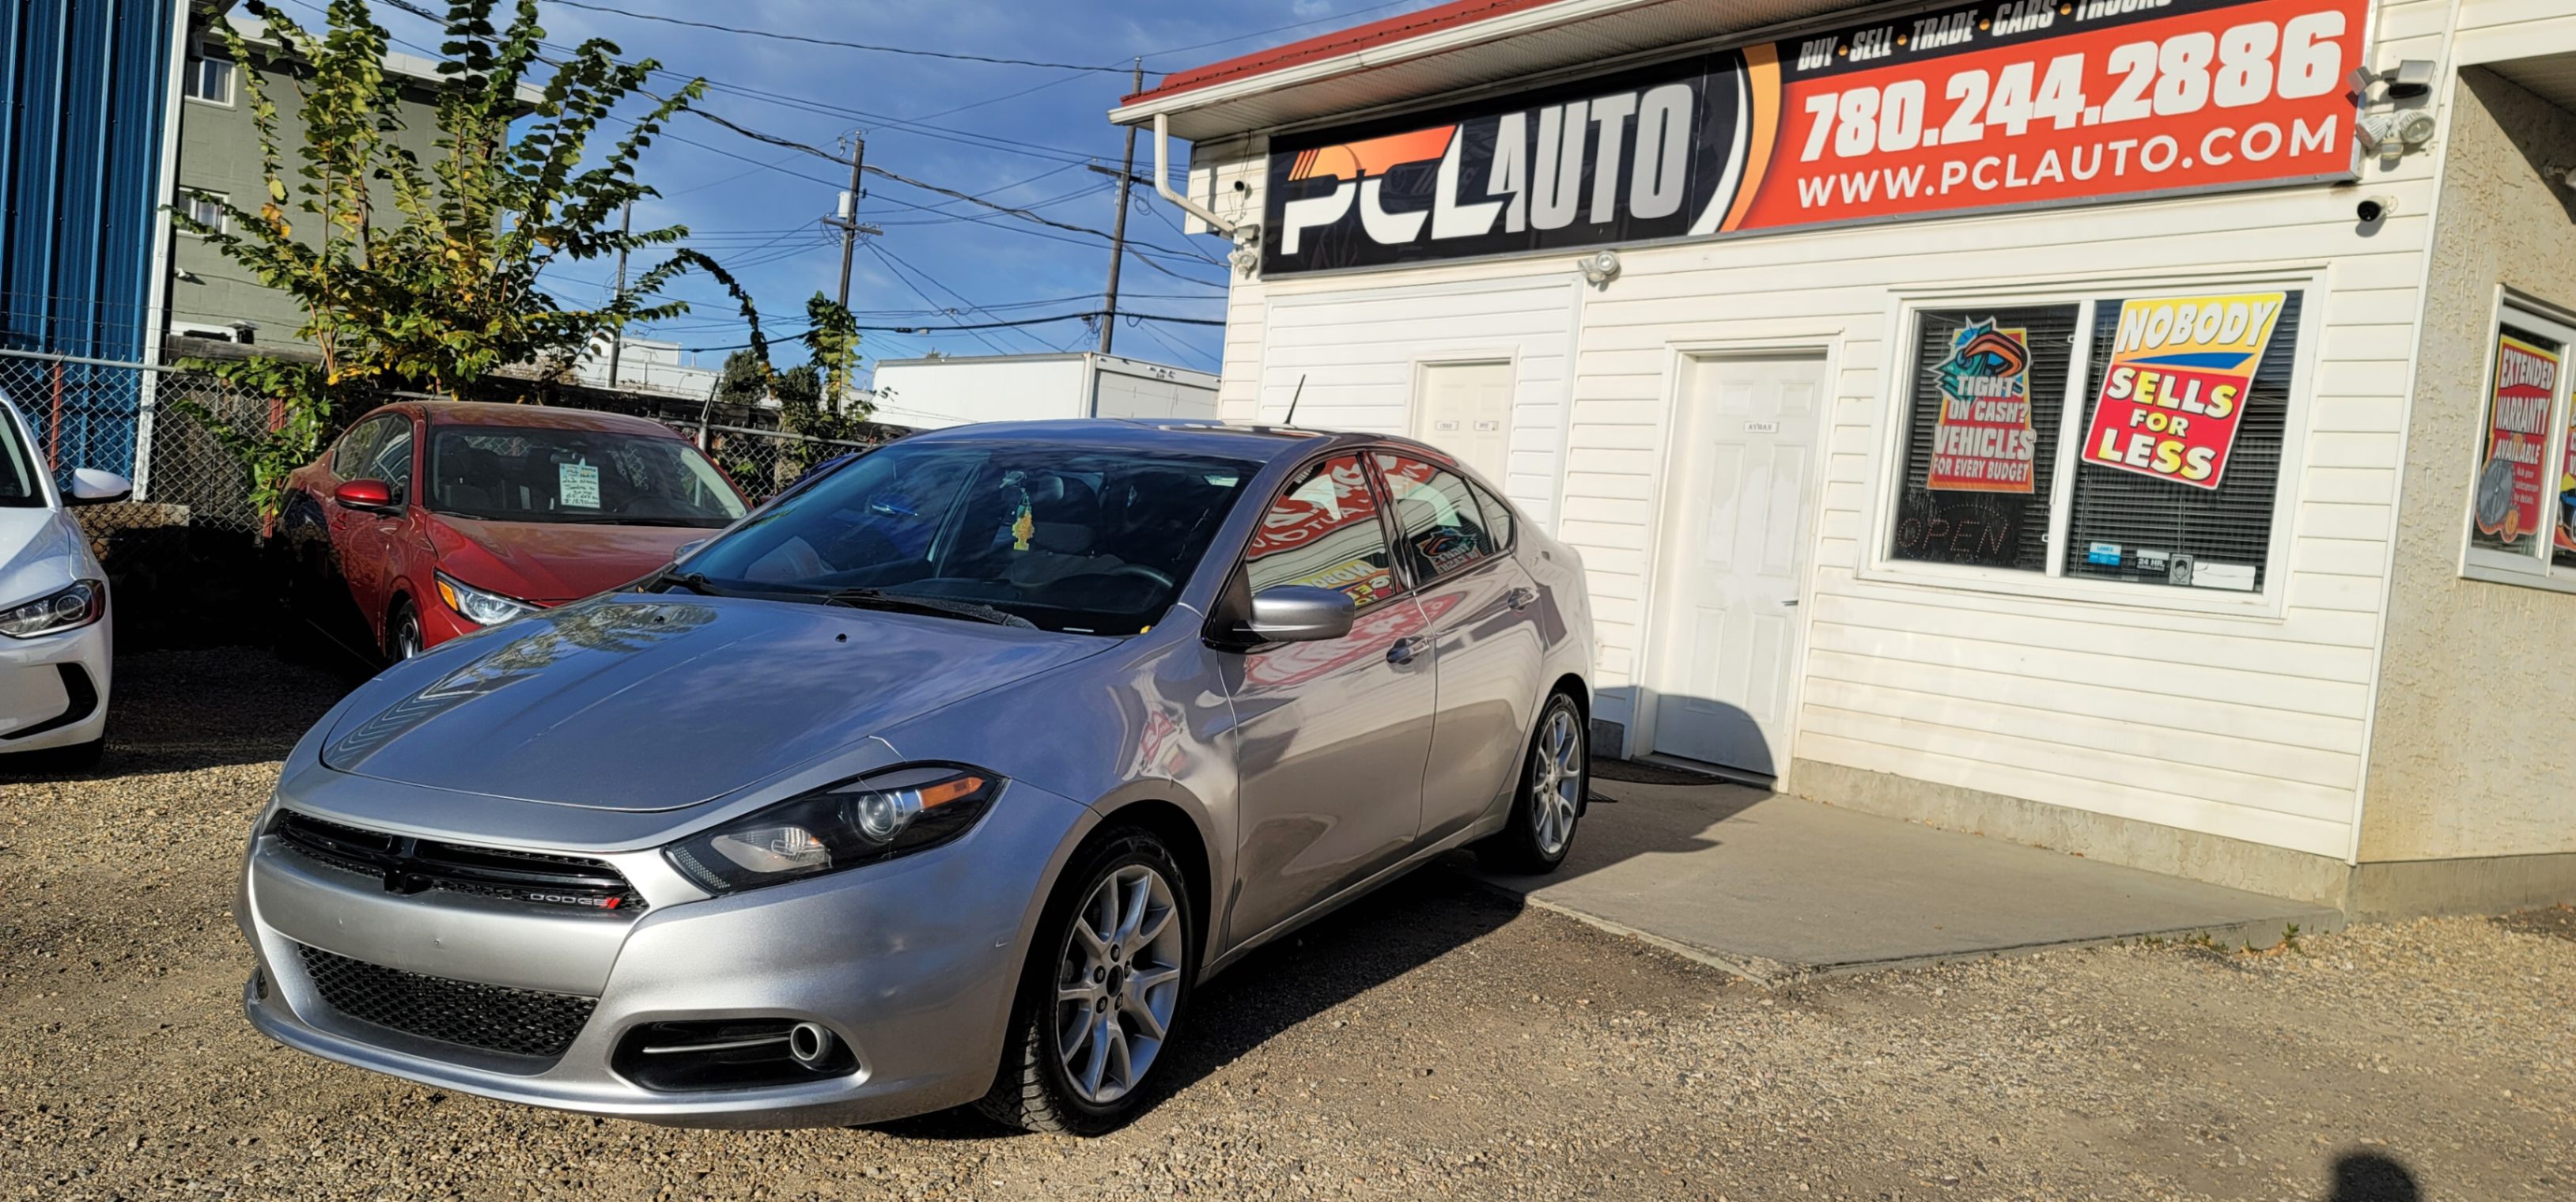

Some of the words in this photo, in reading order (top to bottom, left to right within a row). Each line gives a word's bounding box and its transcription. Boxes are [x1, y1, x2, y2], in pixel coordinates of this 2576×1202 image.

[1797, 37, 1839, 70] BUY
[1849, 27, 1893, 62] SELL
[1910, 9, 1977, 51] TRADE
[1992, 0, 2056, 36] CARS
[2075, 0, 2173, 21] TRU
[1799, 11, 2346, 162] 780.244.2886
[1797, 115, 2338, 208] WWW.PCLAUTO.COM
[2116, 301, 2278, 353] NOBODY
[1956, 375, 2016, 398] TIGHT
[2499, 348, 2555, 391] EXTENDED
[1948, 399, 1971, 421] ON
[1974, 401, 2030, 423] CASH?
[2106, 367, 2238, 419] SELLS
[2129, 408, 2190, 438] FOR
[2496, 396, 2551, 435] WARRANTY
[1935, 425, 2036, 460] VEHICLES
[2097, 427, 2217, 482] LESS
[2494, 438, 2541, 465] AVAILABLE
[1932, 457, 1952, 475] FOR
[1954, 458, 1985, 479] EVERY
[1987, 461, 2029, 482] BUDGET
[1897, 518, 2009, 555] OPEN
[530, 893, 607, 906] DODGE
